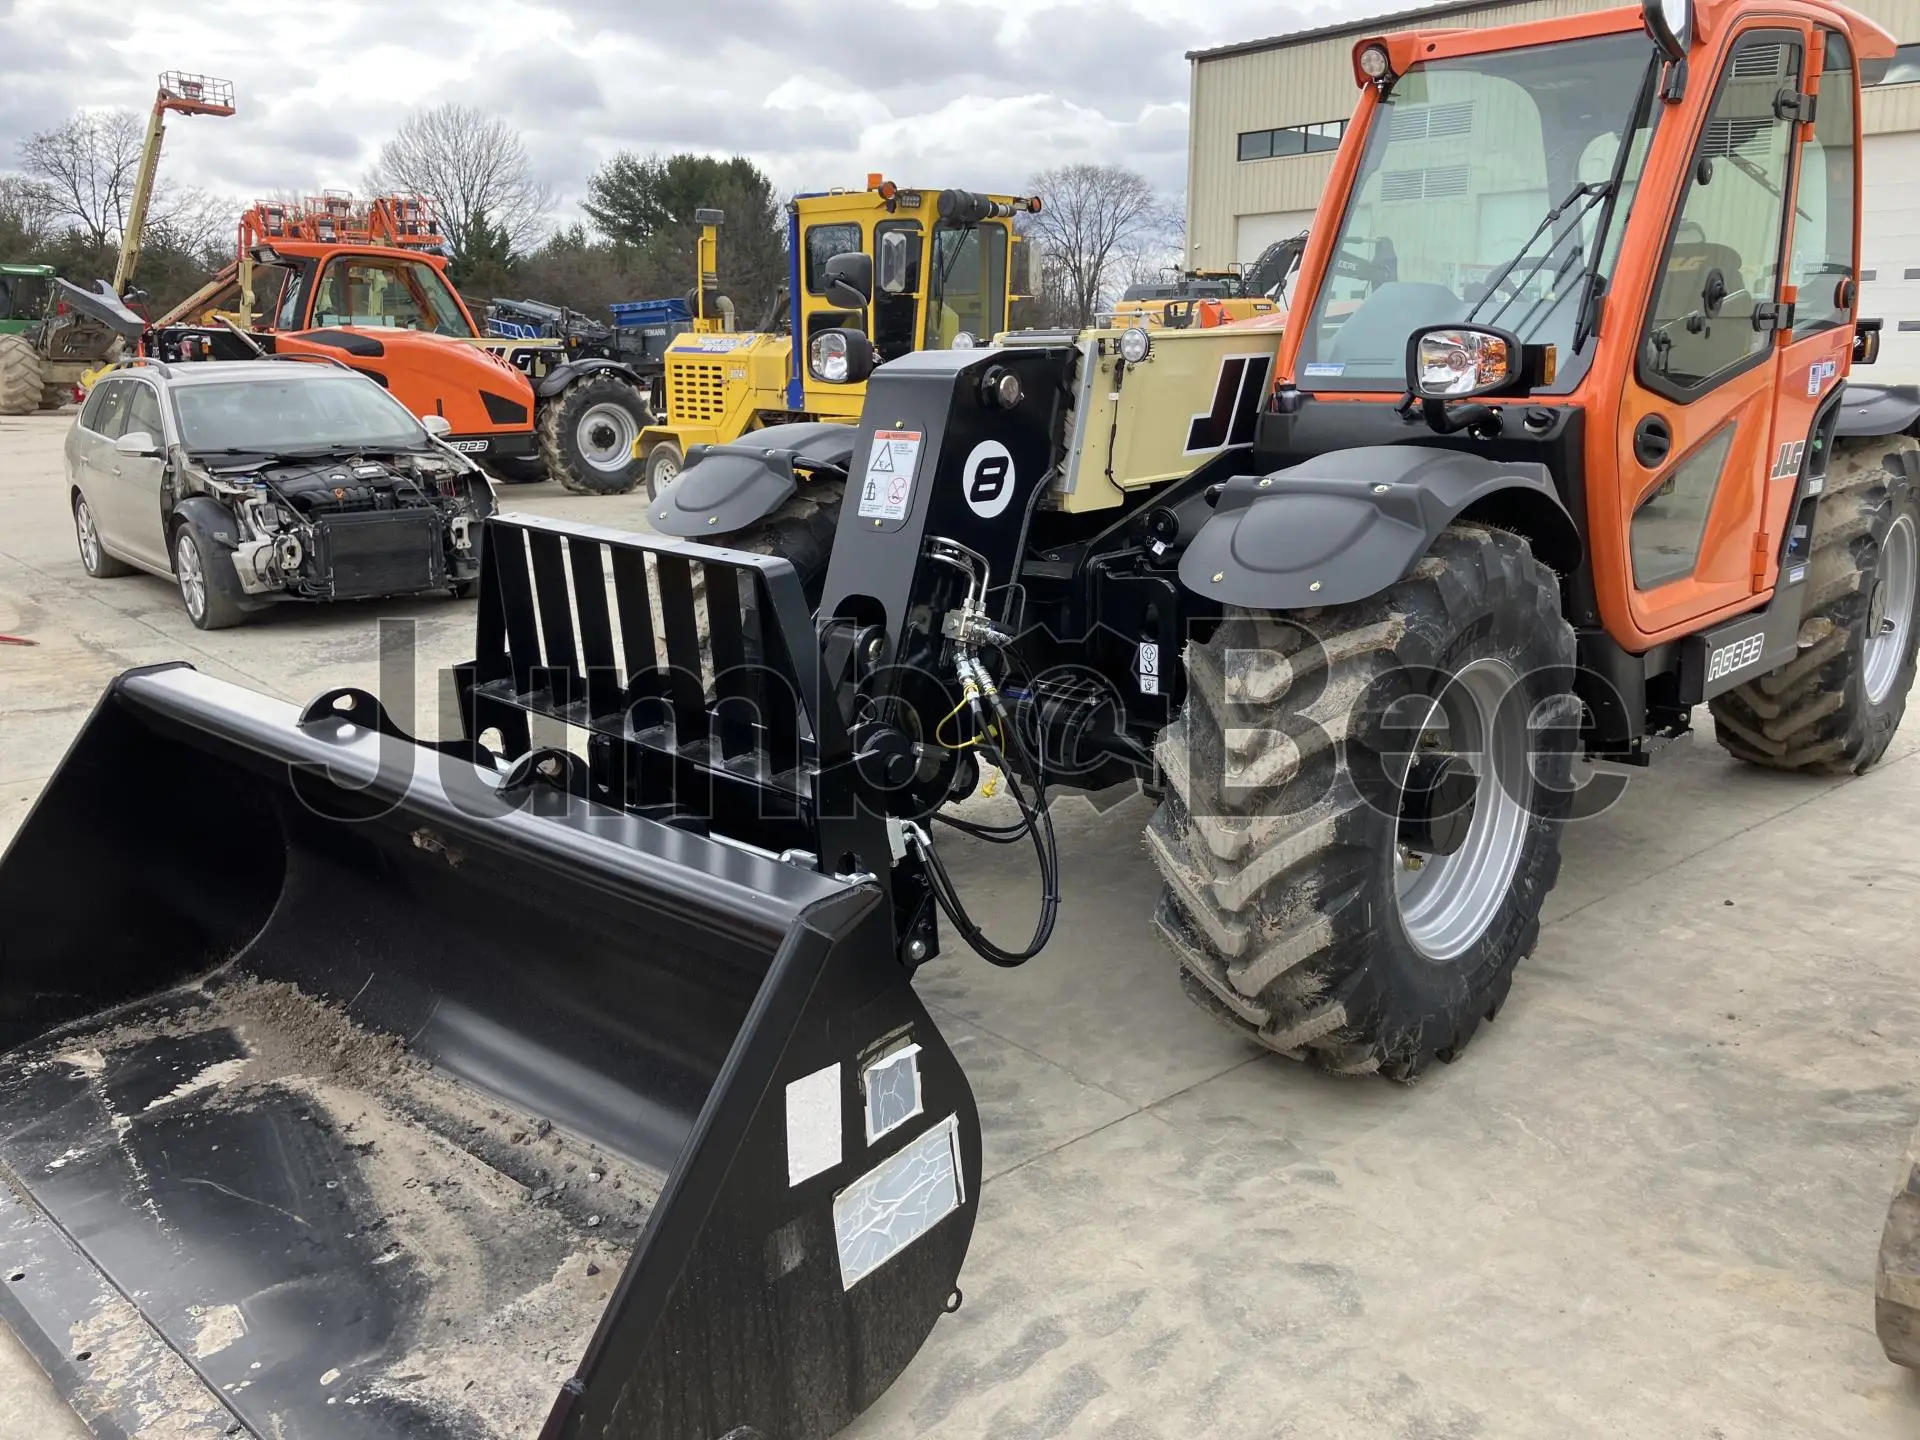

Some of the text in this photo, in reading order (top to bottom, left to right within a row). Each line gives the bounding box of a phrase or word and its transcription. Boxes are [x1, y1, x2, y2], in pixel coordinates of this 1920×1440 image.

[970, 455, 1009, 503] 8
[1770, 440, 1806, 480] JLG
[1708, 632, 1765, 682] AG823
